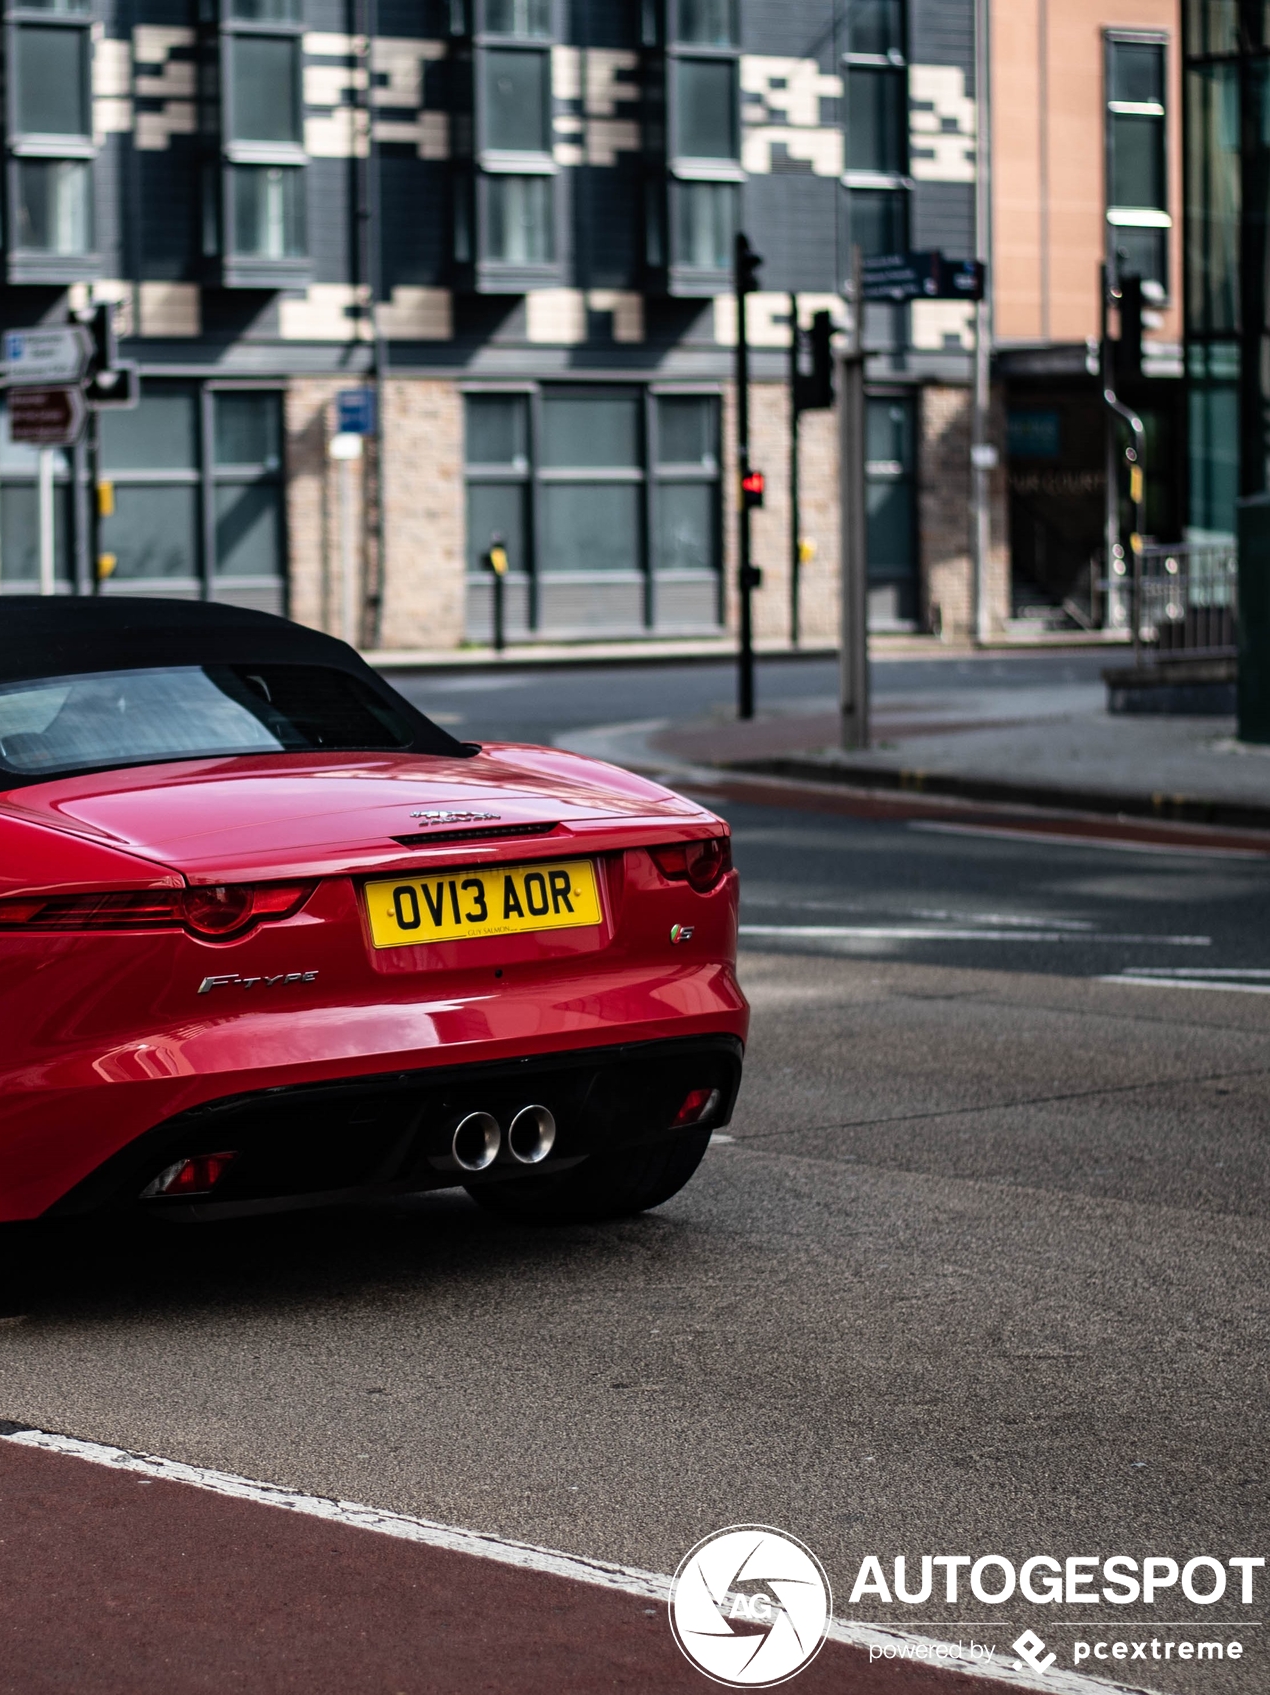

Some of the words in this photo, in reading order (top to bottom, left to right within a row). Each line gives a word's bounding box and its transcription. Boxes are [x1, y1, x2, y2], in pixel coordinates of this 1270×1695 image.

[393, 879, 488, 930] OV13
[503, 870, 575, 919] AOR
[483, 926, 509, 934] SALMON
[197, 970, 319, 993] F-TYPE
